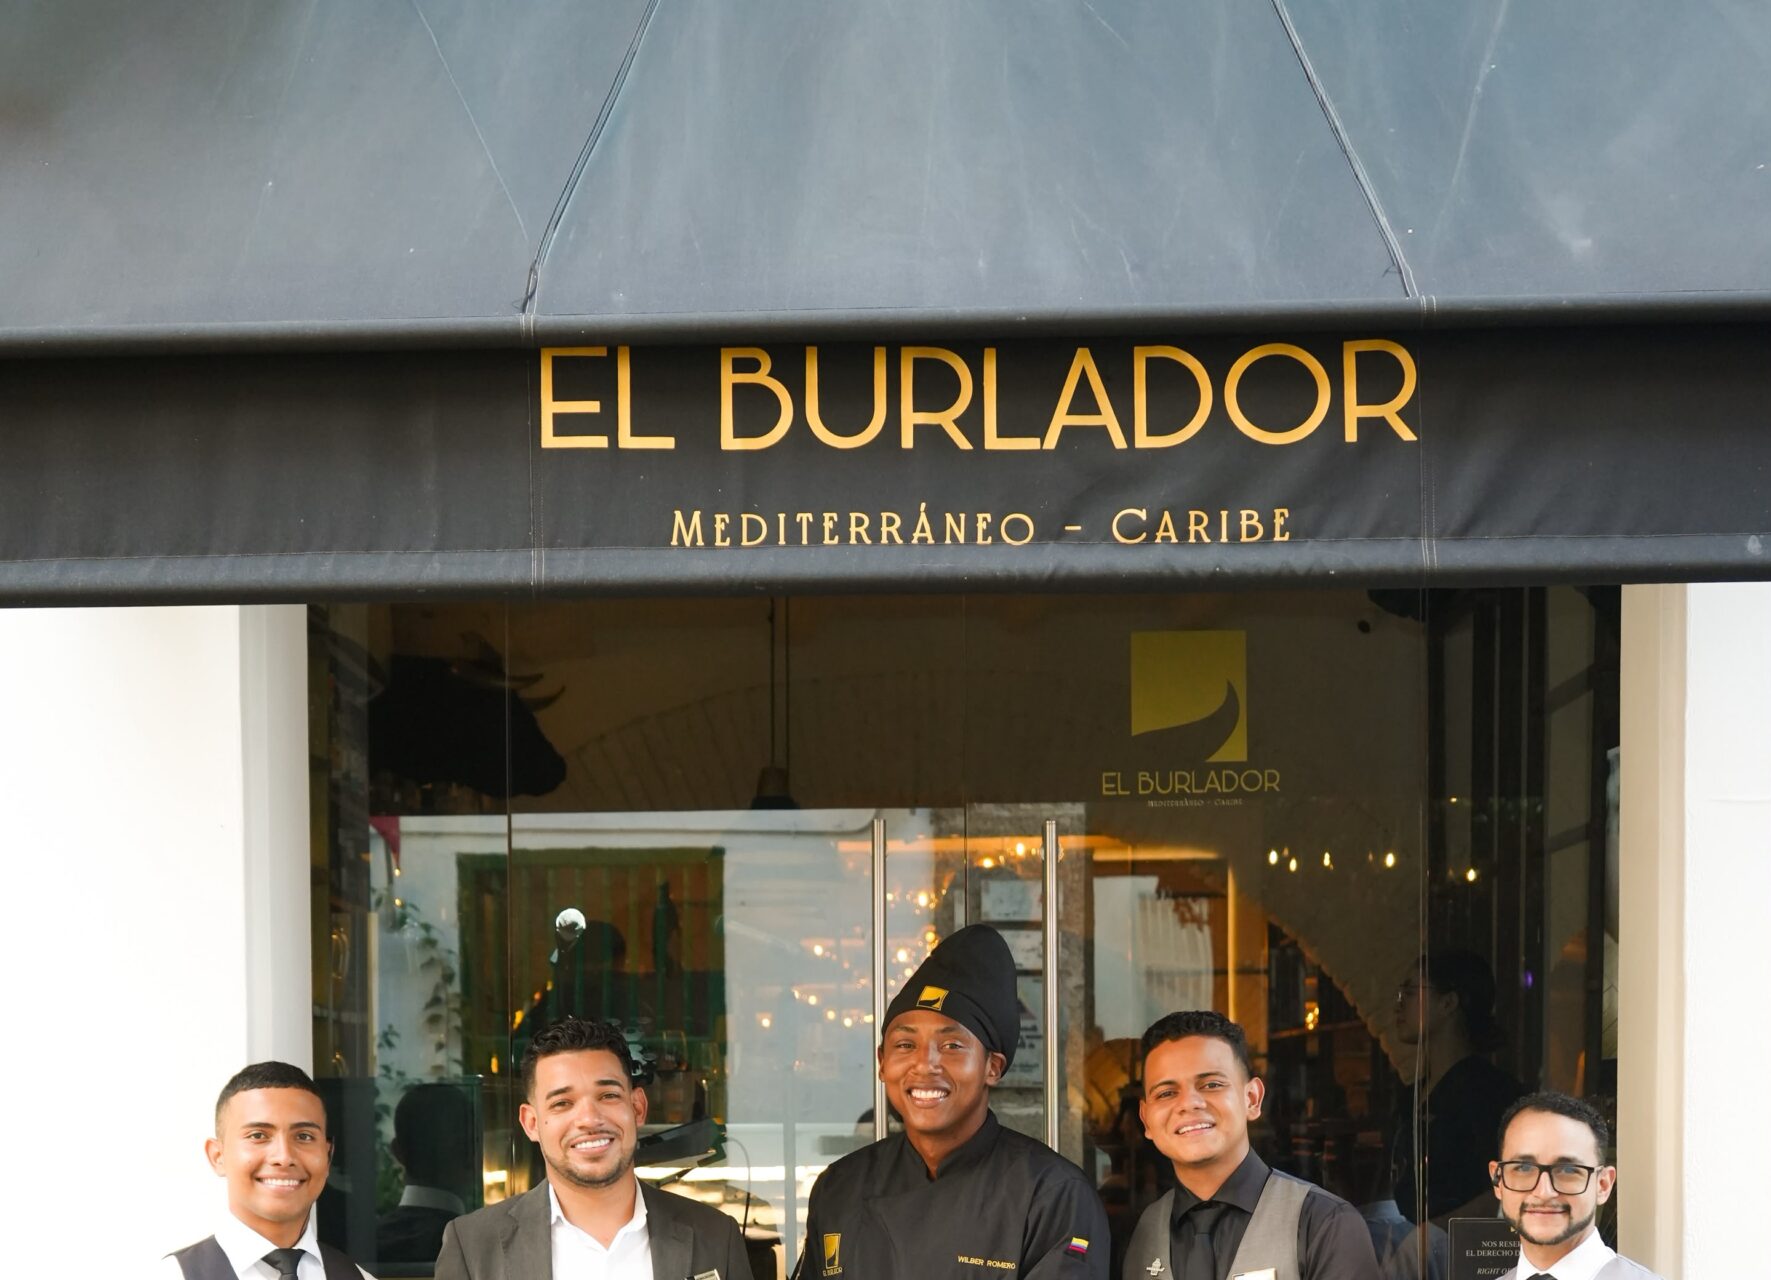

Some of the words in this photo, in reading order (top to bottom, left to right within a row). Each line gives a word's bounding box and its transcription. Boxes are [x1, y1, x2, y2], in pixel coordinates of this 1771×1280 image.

[540, 346, 676, 450] EL
[720, 339, 1418, 452] BURLADOR
[671, 503, 1035, 547] MEDITERRÁNEO
[1112, 507, 1290, 545] CARIBE
[1102, 772, 1130, 795] EL
[1138, 769, 1281, 795] BURLADOR
[958, 1256, 985, 1266] WILBER
[986, 1260, 1016, 1270] ROMERO
